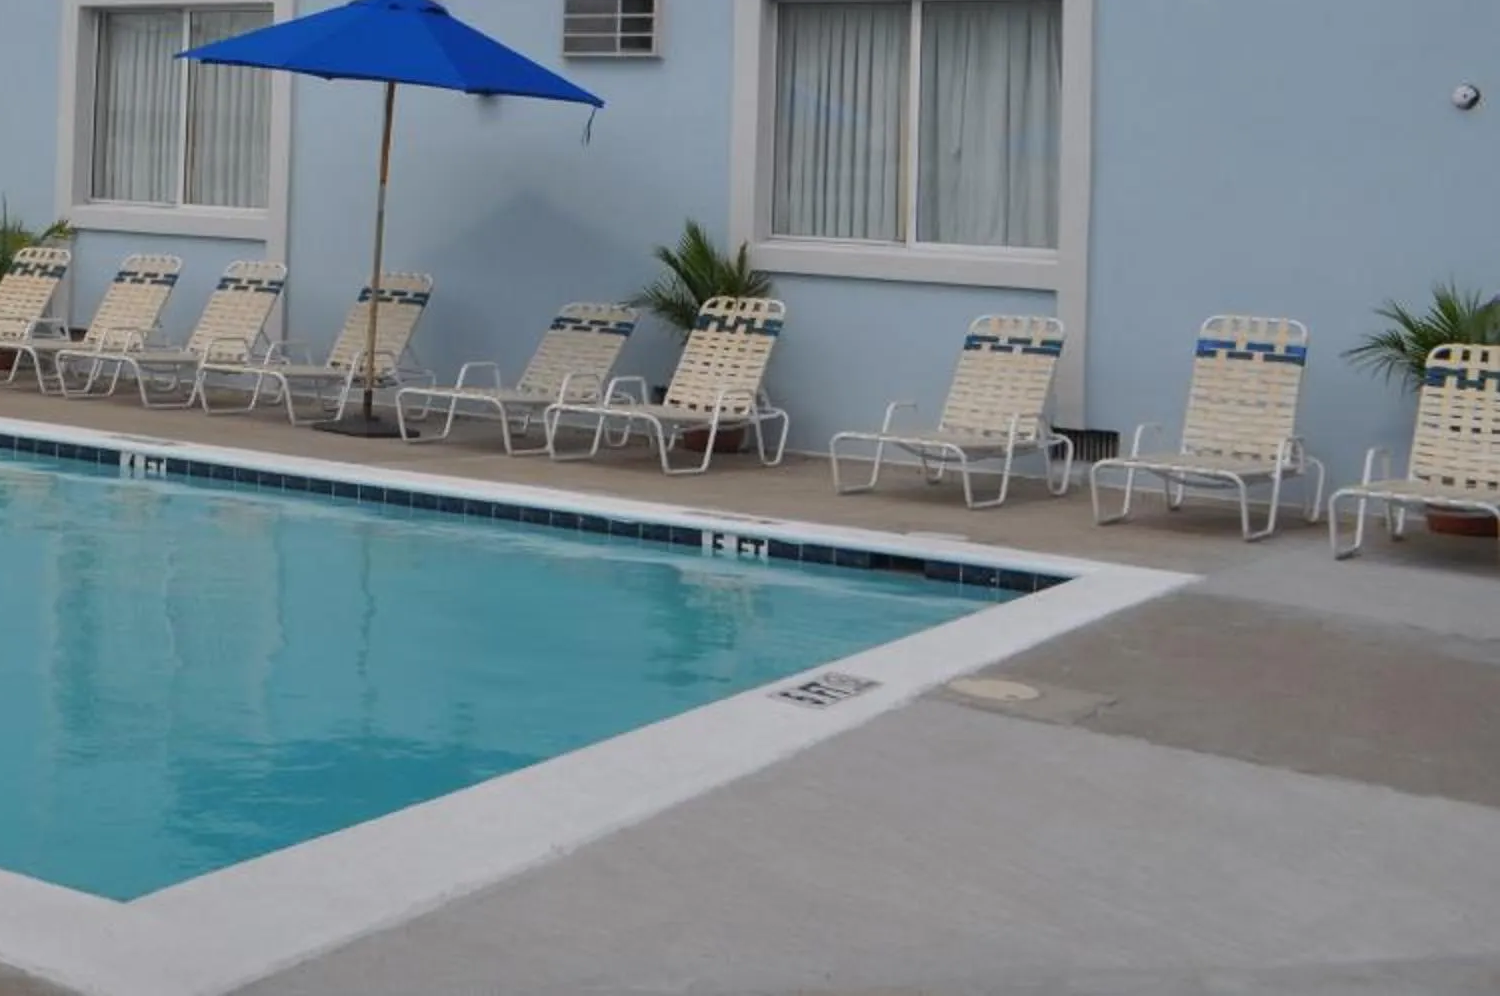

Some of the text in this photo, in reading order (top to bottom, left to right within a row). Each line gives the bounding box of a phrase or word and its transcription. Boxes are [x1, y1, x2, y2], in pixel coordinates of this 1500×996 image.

[145, 456, 165, 472] FT
[712, 531, 765, 555] 5 FT
[797, 680, 852, 700] FT
